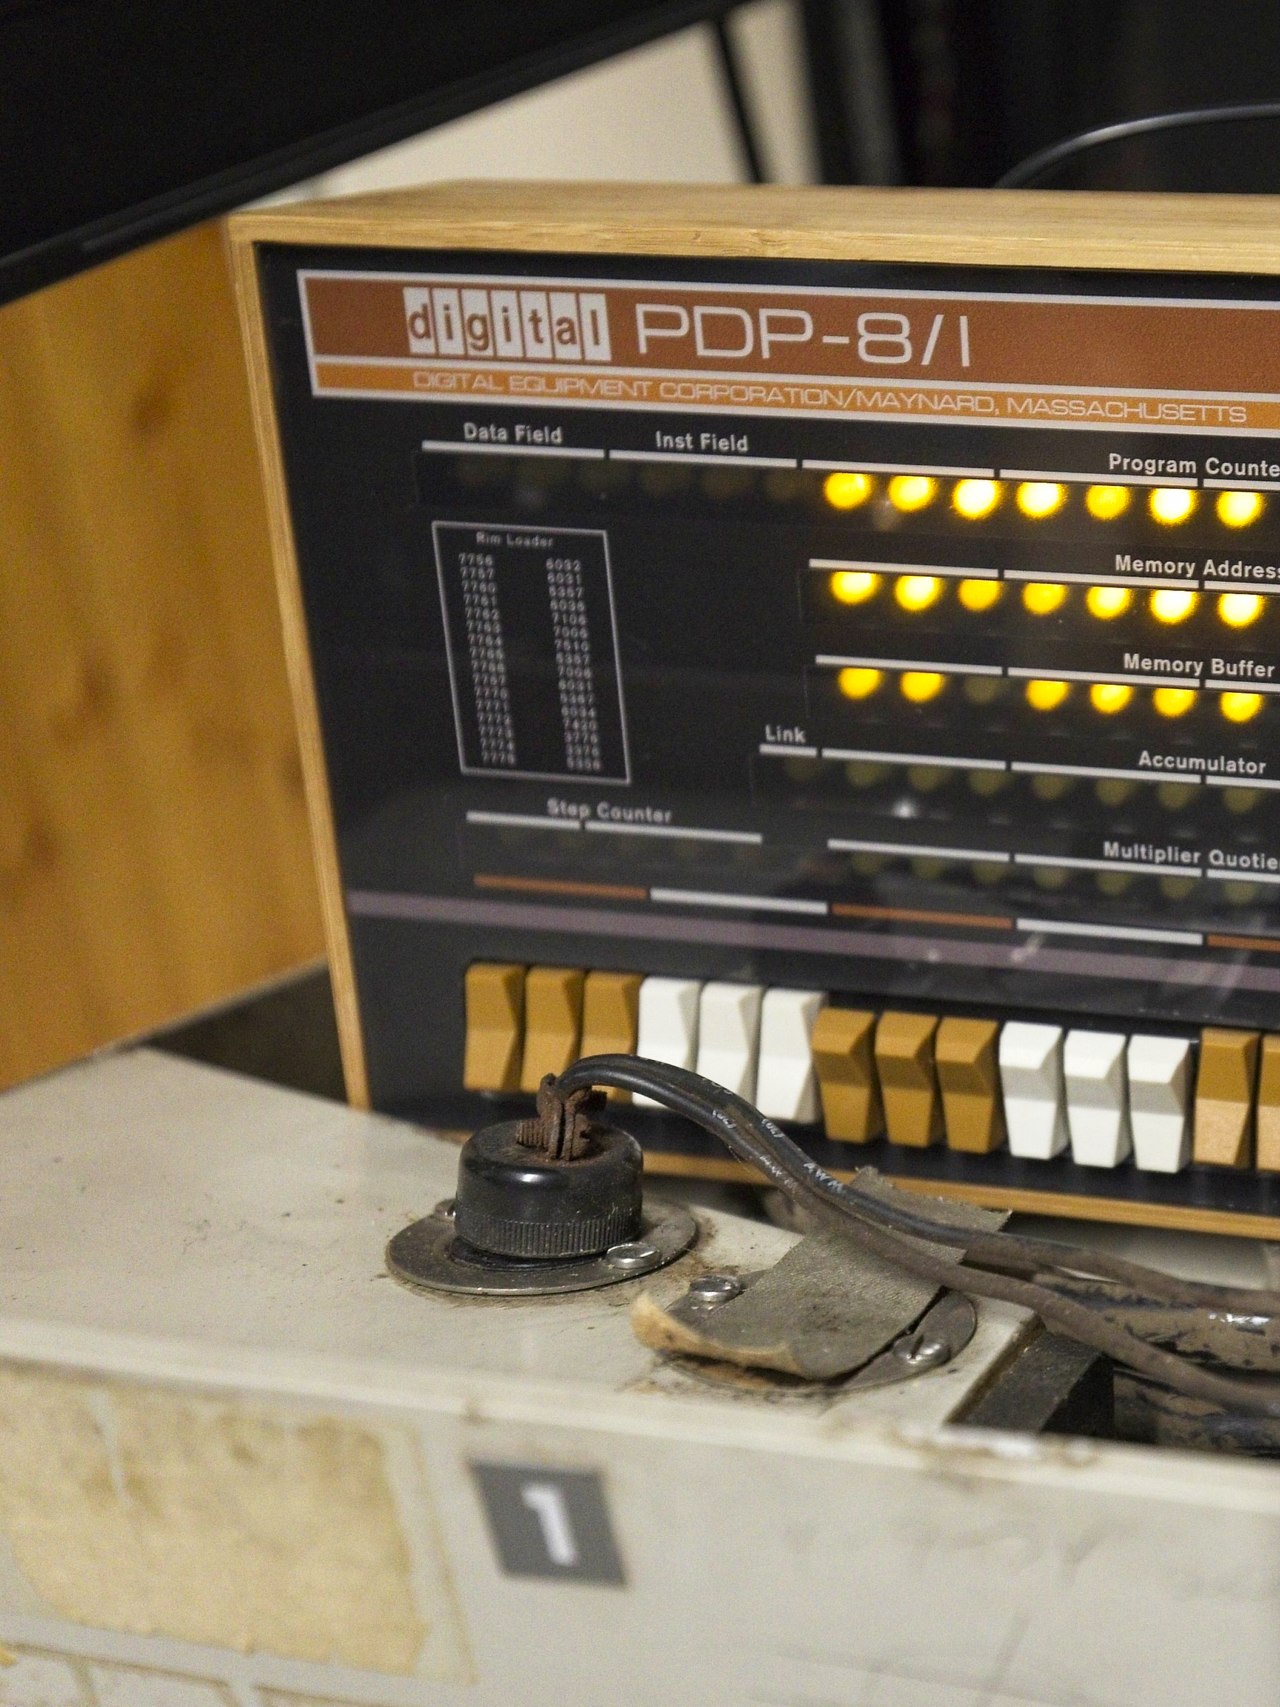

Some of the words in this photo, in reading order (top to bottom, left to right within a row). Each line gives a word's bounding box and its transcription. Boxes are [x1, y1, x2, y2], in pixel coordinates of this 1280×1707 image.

[407, 301, 603, 353] digital
[635, 303, 970, 367] PDP-8/I
[412, 371, 504, 391] DIGITAL
[509, 374, 653, 397] EQUIPMENT
[659, 380, 1000, 415] CORPORATION/MAYNARD,
[1006, 396, 1248, 424] MASSACHUSETTS
[464, 423, 507, 441] Data
[515, 425, 562, 444] Field
[656, 431, 693, 449] Inst
[701, 433, 748, 452] Field
[1109, 453, 1196, 475] Program
[476, 531, 502, 545] Rim
[506, 533, 554, 548] Loader
[459, 552, 494, 566] 7756
[546, 558, 581, 572] 6032
[1116, 555, 1195, 577] Memory
[462, 579, 496, 592] 7760
[465, 605, 500, 619] 7762
[1124, 653, 1203, 676] Memory
[1212, 658, 1275, 677] Buffer
[766, 725, 805, 743] Link
[1138, 750, 1266, 774] Accumulator
[547, 798, 590, 819] Step
[597, 801, 672, 823] Counter
[1103, 841, 1200, 864] Multiplier
[803, 1162, 845, 1194] AWM
[520, 1482, 577, 1567] 1
